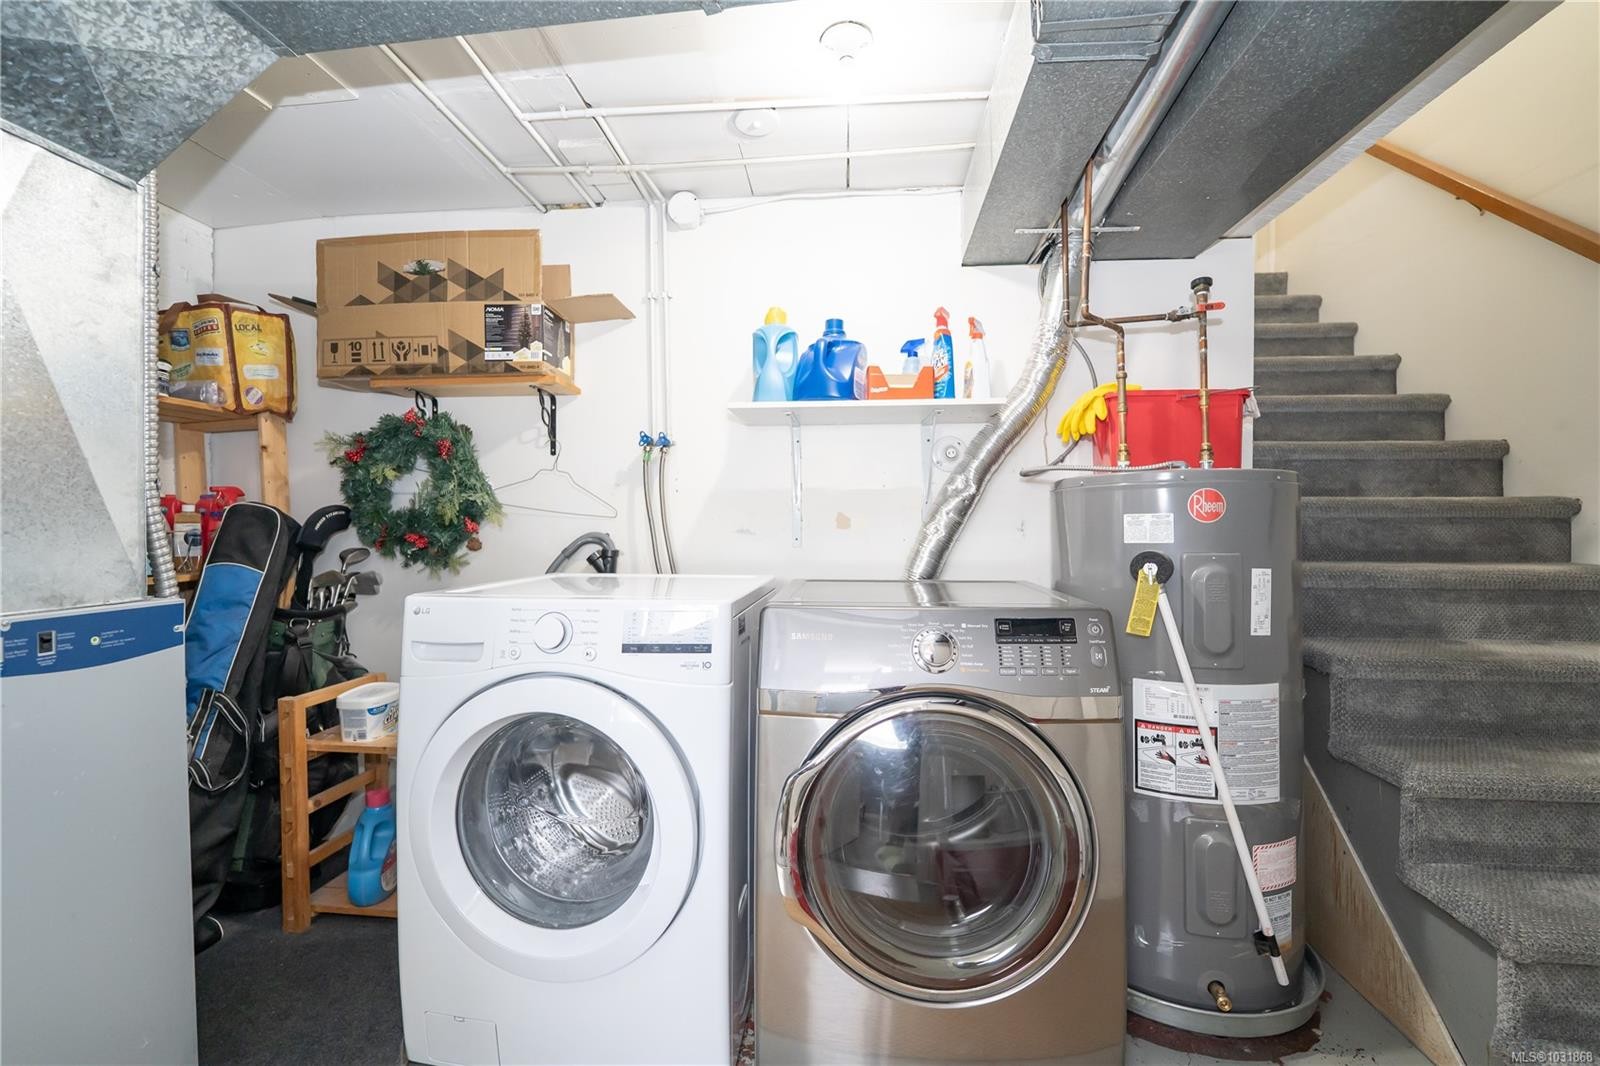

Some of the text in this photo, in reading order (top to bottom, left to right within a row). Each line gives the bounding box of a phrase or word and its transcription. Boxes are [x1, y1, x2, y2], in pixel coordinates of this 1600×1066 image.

[234, 323, 262, 334] LOCAL
[348, 341, 362, 351] 10
[1192, 489, 1224, 517] Rheem
[791, 632, 833, 641] SAMSUNG
[1147, 723, 1173, 731] DANGER
